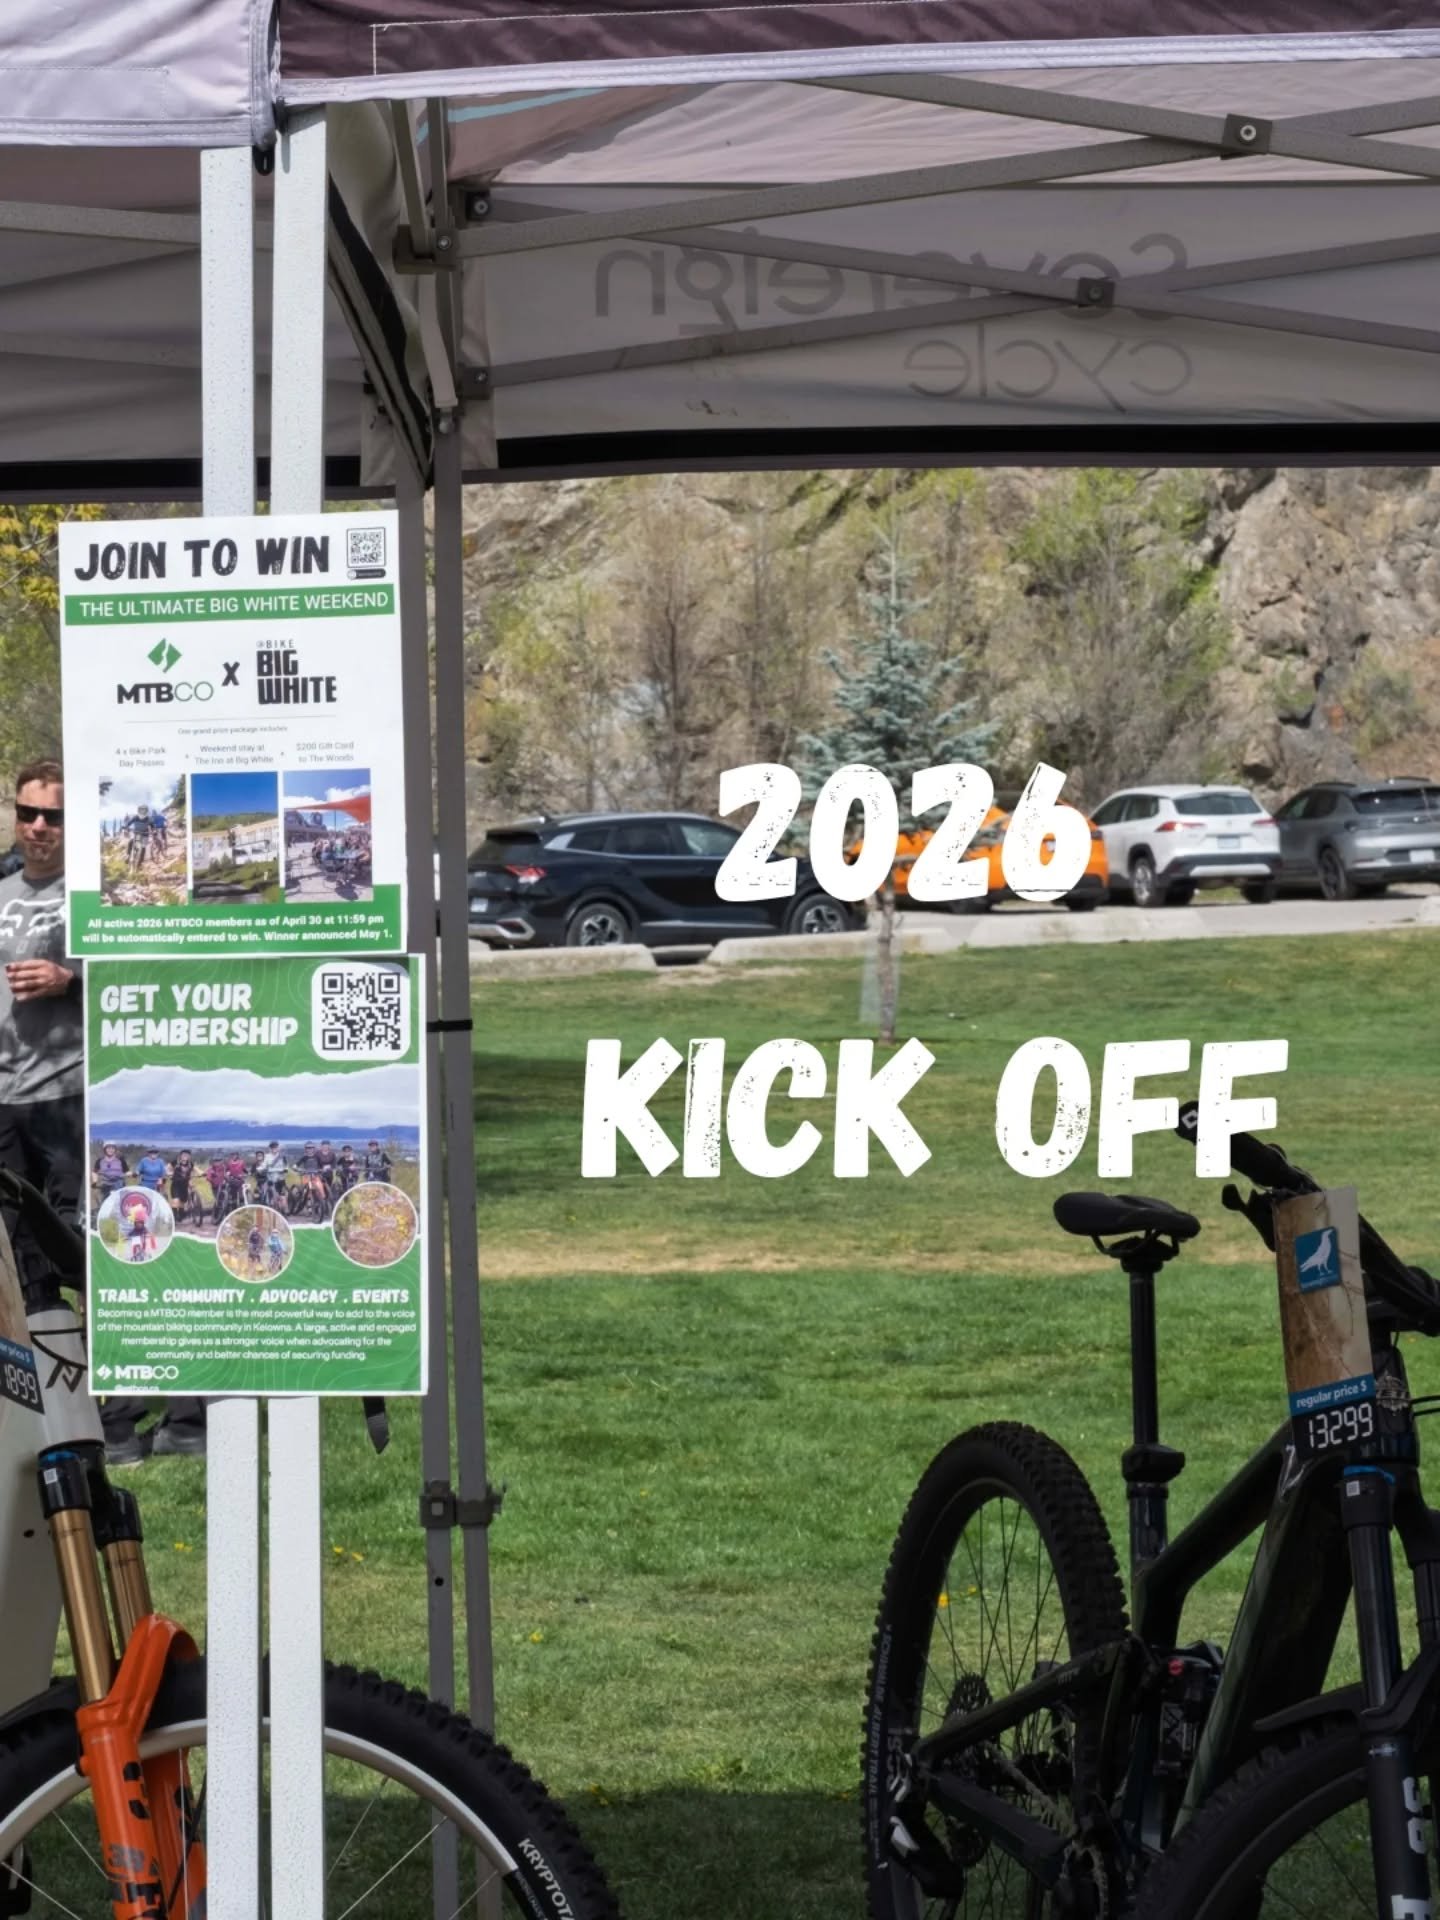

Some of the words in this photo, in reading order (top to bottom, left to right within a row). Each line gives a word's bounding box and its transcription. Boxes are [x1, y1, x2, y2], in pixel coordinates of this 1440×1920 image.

[74, 541, 167, 581] JOIN
[183, 538, 238, 577] TO
[255, 535, 330, 575] WIN
[79, 601, 114, 617] THE
[118, 599, 205, 616] ULTIMATE
[210, 597, 239, 614] BIG
[243, 594, 300, 612] WHITE
[304, 591, 389, 610] WEEKEND
[256, 649, 299, 676] BIG
[117, 682, 214, 705] MTBCO
[256, 676, 337, 705] WHITE
[128, 747, 146, 755] Bike
[148, 746, 166, 754] Park
[200, 744, 236, 752] Weekend
[238, 745, 256, 754] stay
[296, 742, 317, 752] $200
[318, 742, 333, 750] Gift
[334, 742, 354, 750] Card
[119, 760, 134, 768] Day
[195, 756, 210, 764] The
[236, 756, 249, 766] Big
[250, 756, 274, 764] White
[326, 754, 354, 762] Woods
[88, 918, 102, 928] All
[104, 919, 135, 928] active
[136, 918, 162, 928] 2026
[164, 918, 203, 928] MTBCO
[205, 917, 252, 927] members
[254, 917, 267, 926] as
[268, 916, 280, 926] of
[282, 916, 307, 927] April
[308, 916, 322, 925] 30
[324, 916, 334, 925] at
[338, 914, 366, 924] 11:59
[368, 916, 384, 926] pm
[82, 933, 100, 942] will
[102, 933, 114, 942] be
[116, 932, 185, 944] automatically
[186, 932, 226, 942] entered
[227, 932, 238, 942] to
[240, 931, 262, 942] win.
[264, 930, 299, 940] Winner
[301, 928, 356, 940] announced
[358, 928, 380, 941] May
[382, 928, 393, 939] 1.
[100, 984, 160, 1013] GET
[171, 983, 252, 1012] YOUR
[101, 1016, 298, 1047] MEMBERSHIP
[98, 1288, 149, 1303] TRAILS
[162, 1288, 246, 1303] COMMUNITY
[259, 1288, 338, 1303] ADVOCACY
[352, 1288, 410, 1303] EVENTS
[97, 1308, 142, 1319] Becoming
[150, 1308, 186, 1318] MTBCO
[187, 1308, 225, 1318] member
[226, 1308, 234, 1318] is
[235, 1308, 250, 1318] the
[251, 1310, 274, 1318] most
[274, 1309, 314, 1320] powerful
[316, 1311, 333, 1320] way
[335, 1310, 345, 1318] to
[346, 1309, 364, 1318] add
[364, 1310, 375, 1318] to
[376, 1309, 390, 1318] the
[392, 1309, 416, 1318] voice
[96, 1322, 106, 1332] of
[108, 1322, 122, 1332] the
[124, 1322, 165, 1332] mountain
[166, 1322, 193, 1333] biking
[194, 1323, 243, 1333] community
[244, 1323, 252, 1332] in
[252, 1323, 292, 1332] Kelowna.
[294, 1323, 303, 1332] A
[304, 1323, 329, 1334] large,
[330, 1323, 358, 1332] active
[358, 1323, 375, 1332] and
[376, 1323, 417, 1334] engaged
[121, 1337, 177, 1347] membership
[178, 1338, 202, 1347] gives
[202, 1338, 214, 1346] us
[222, 1337, 259, 1347] stronger
[260, 1336, 285, 1346] voice
[286, 1336, 311, 1346] when
[312, 1336, 362, 1348] advocating
[362, 1336, 376, 1346] for
[376, 1336, 392, 1346] the
[146, 1351, 195, 1361] community
[196, 1351, 213, 1360] and
[214, 1351, 242, 1360] better
[242, 1350, 280, 1360] chances
[280, 1350, 292, 1360] of
[292, 1350, 330, 1362] securing
[114, 1365, 179, 1380] MTBCO
[1296, 1391, 1333, 1408] regular
[1334, 1385, 1359, 1401] price
[1360, 1382, 1367, 1394] $
[1308, 1402, 1373, 1449] 13299
